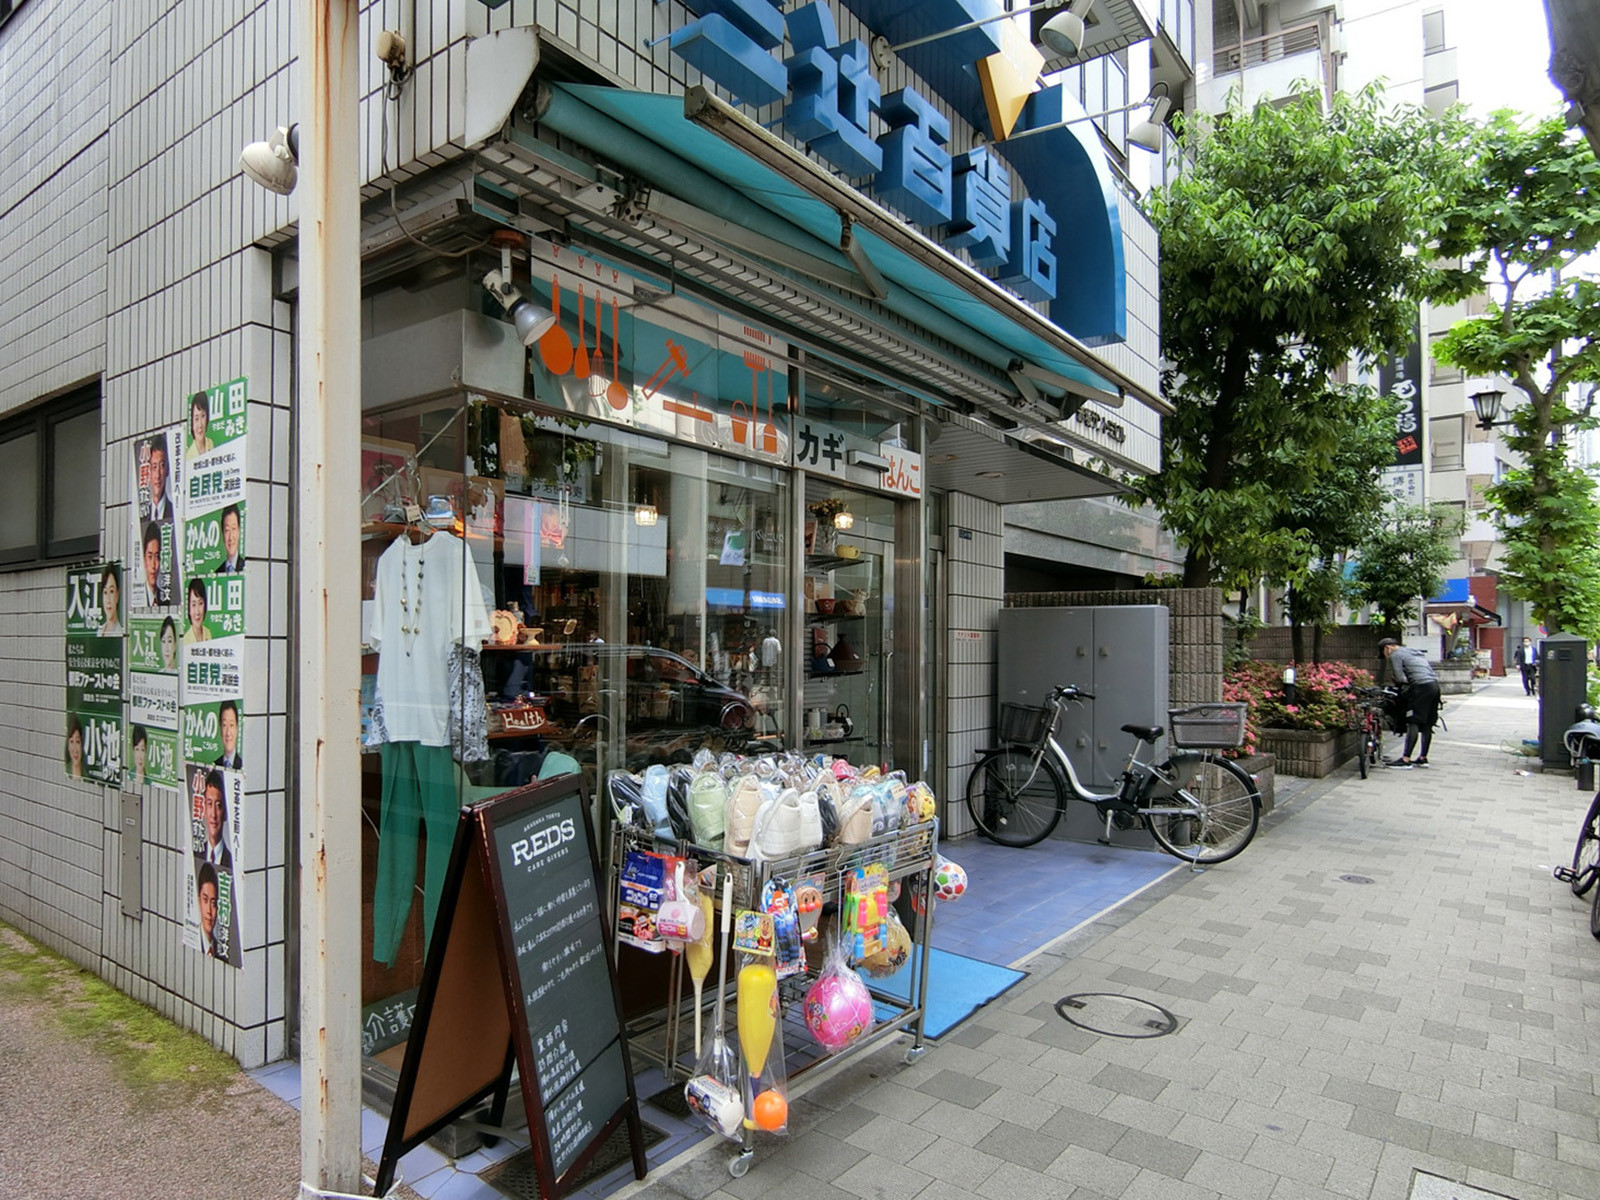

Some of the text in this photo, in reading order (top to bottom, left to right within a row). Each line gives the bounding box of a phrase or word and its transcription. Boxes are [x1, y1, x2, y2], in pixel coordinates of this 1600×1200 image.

[208, 381, 246, 421] 山田
[224, 415, 244, 438] みき
[796, 424, 845, 472] カギ
[189, 470, 223, 499] 自民党
[881, 453, 921, 494] はんこ
[186, 520, 221, 552] かんの
[67, 571, 103, 620] 入江
[207, 579, 243, 612] 山田
[223, 612, 243, 633] みき
[132, 630, 157, 658] 入江
[68, 670, 120, 690] 都民ファーストの会
[187, 661, 221, 686] 自民党
[132, 694, 177, 713] 都民ファーストの会
[502, 710, 546, 729] Health
[185, 707, 218, 739] かんの
[83, 718, 121, 768] 小池
[148, 739, 174, 771] 小池
[523, 812, 562, 833] AKASAKA TOKYO
[510, 817, 576, 867] REDS
[526, 846, 570, 873] CARE GIVERS
[536, 1017, 570, 1055] 業務内容
[537, 1039, 568, 1074] 訪問介護
